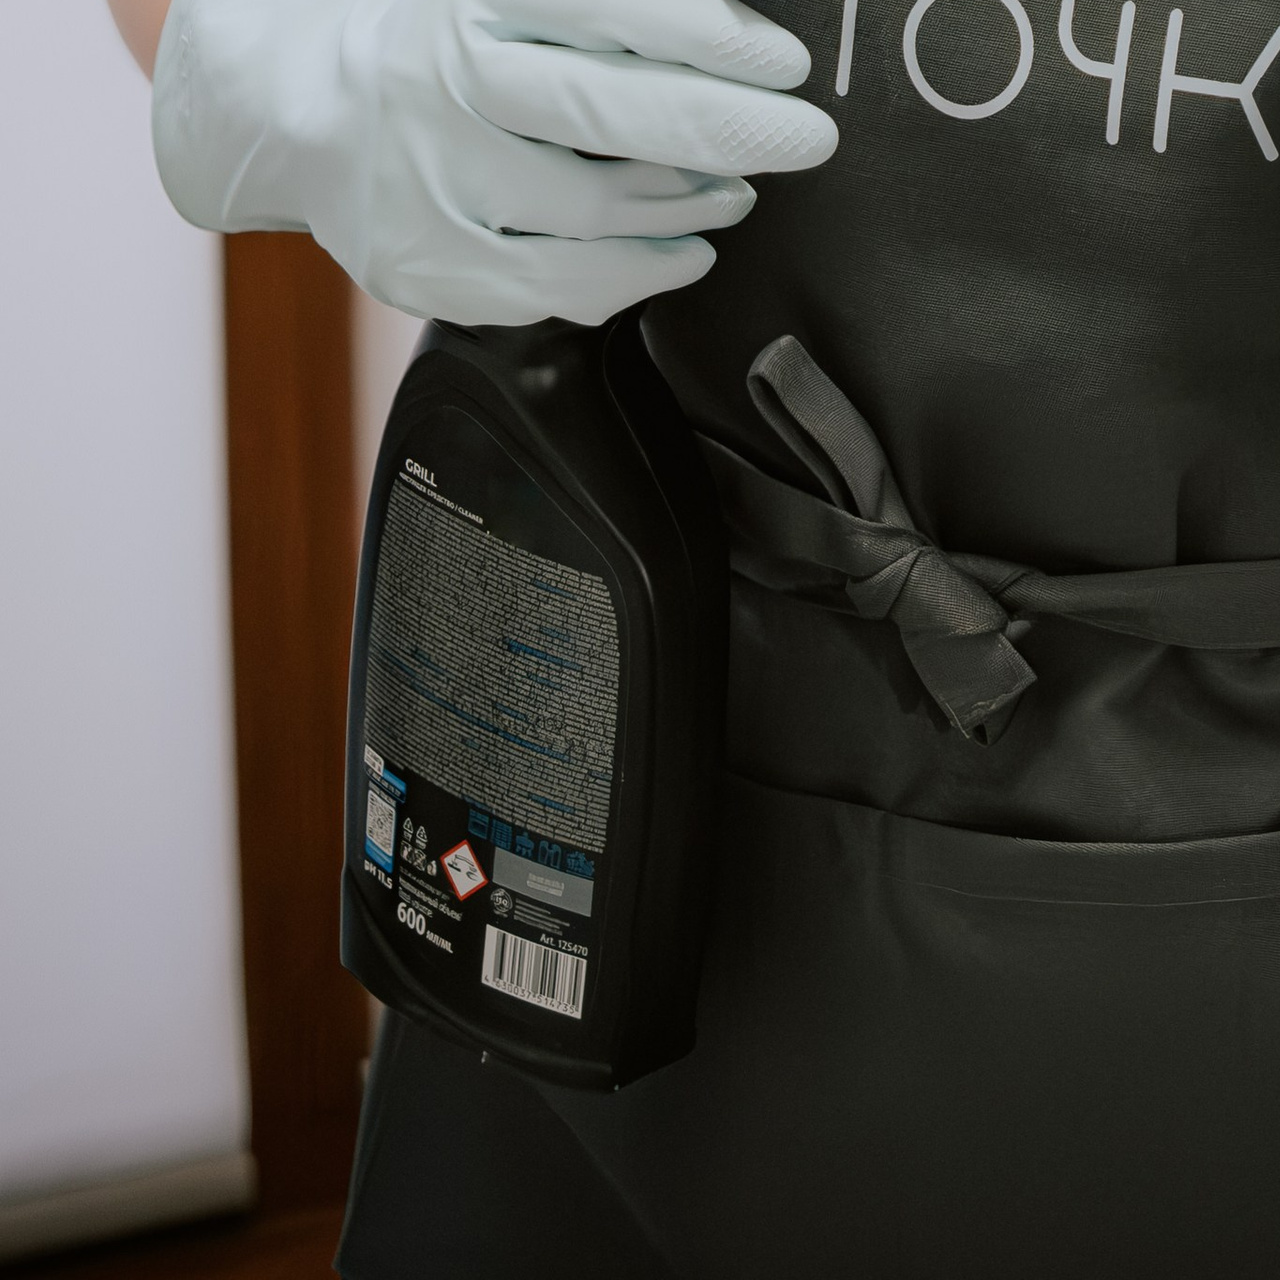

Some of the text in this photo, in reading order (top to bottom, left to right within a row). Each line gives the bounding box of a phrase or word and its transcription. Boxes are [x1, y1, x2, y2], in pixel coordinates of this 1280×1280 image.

[405, 458, 438, 488] GRILL
[458, 506, 484, 525] CLEANER
[397, 902, 426, 935] 600
[558, 939, 588, 956] 125470
